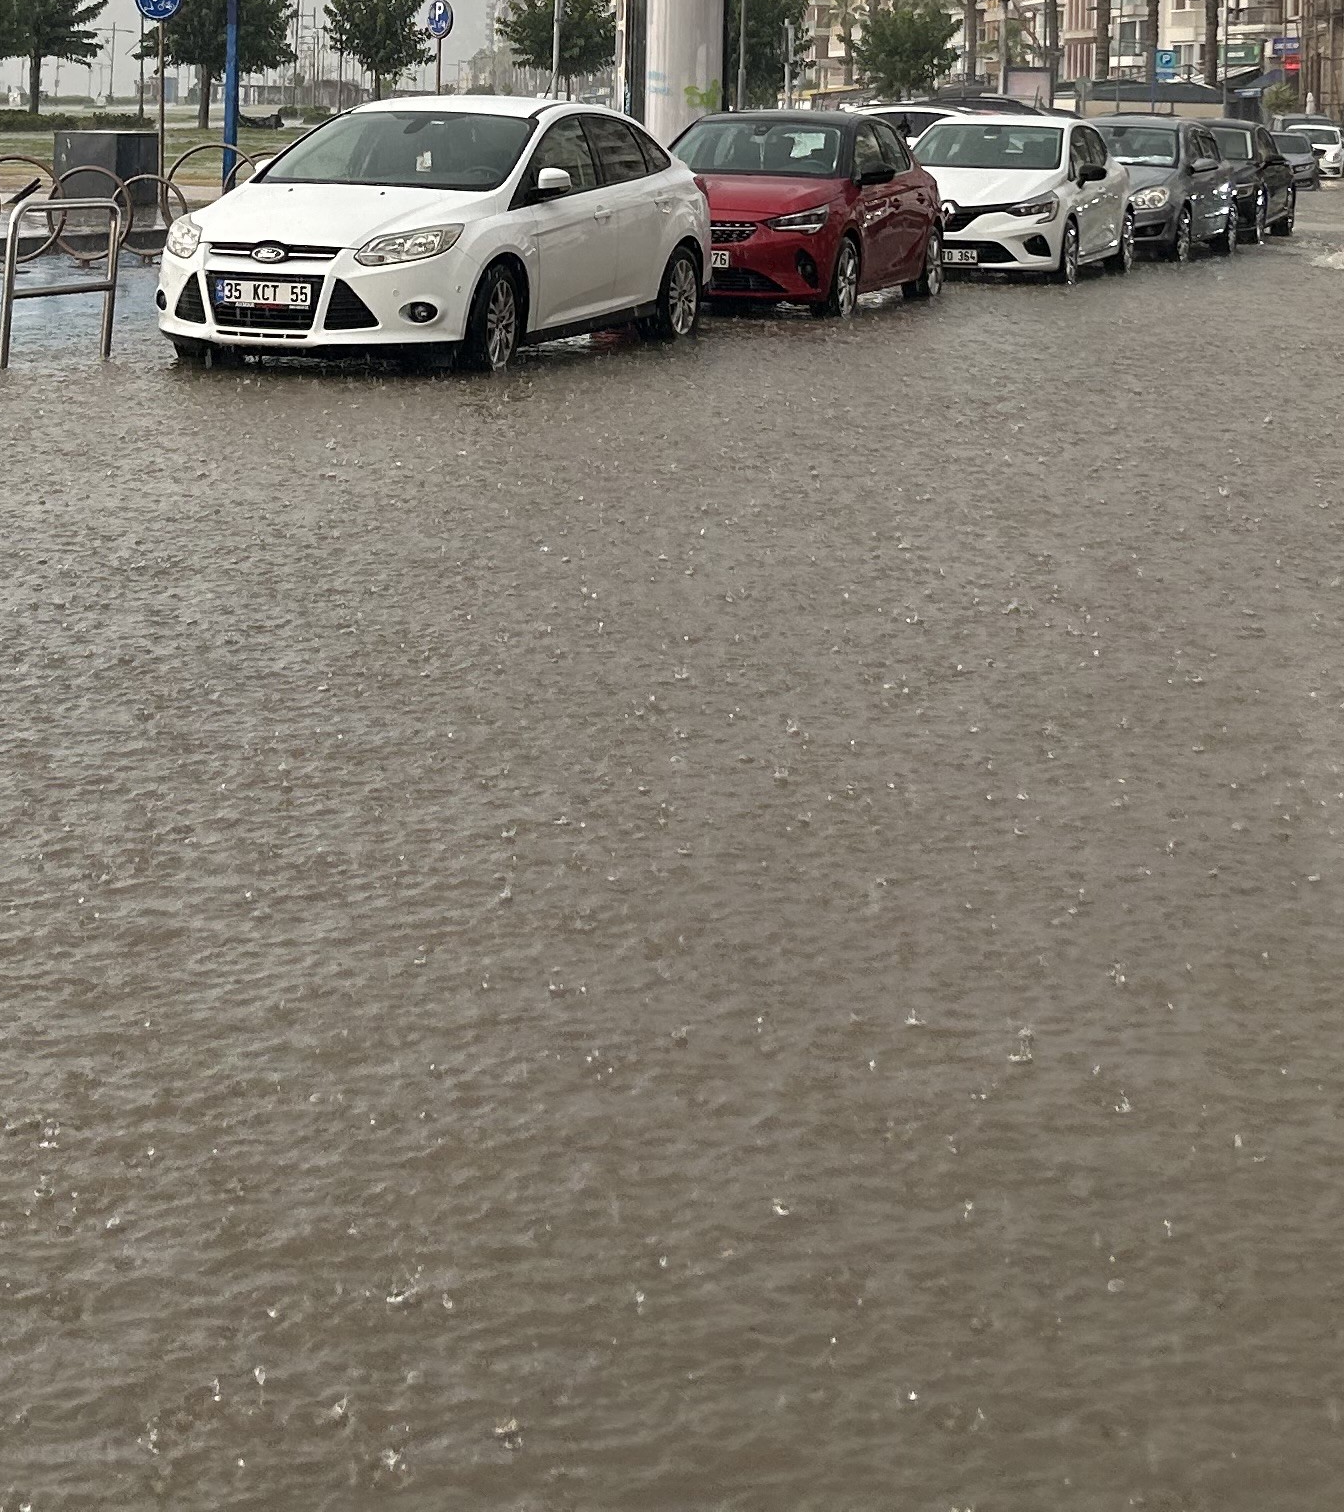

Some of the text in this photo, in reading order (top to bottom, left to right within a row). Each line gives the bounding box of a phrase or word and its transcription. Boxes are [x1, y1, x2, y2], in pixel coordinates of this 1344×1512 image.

[435, 1, 444, 21] P
[1162, 54, 1171, 64] P
[712, 252, 727, 266] 76
[225, 282, 242, 300] 35
[252, 283, 279, 302] KCT
[290, 285, 308, 303] 55
